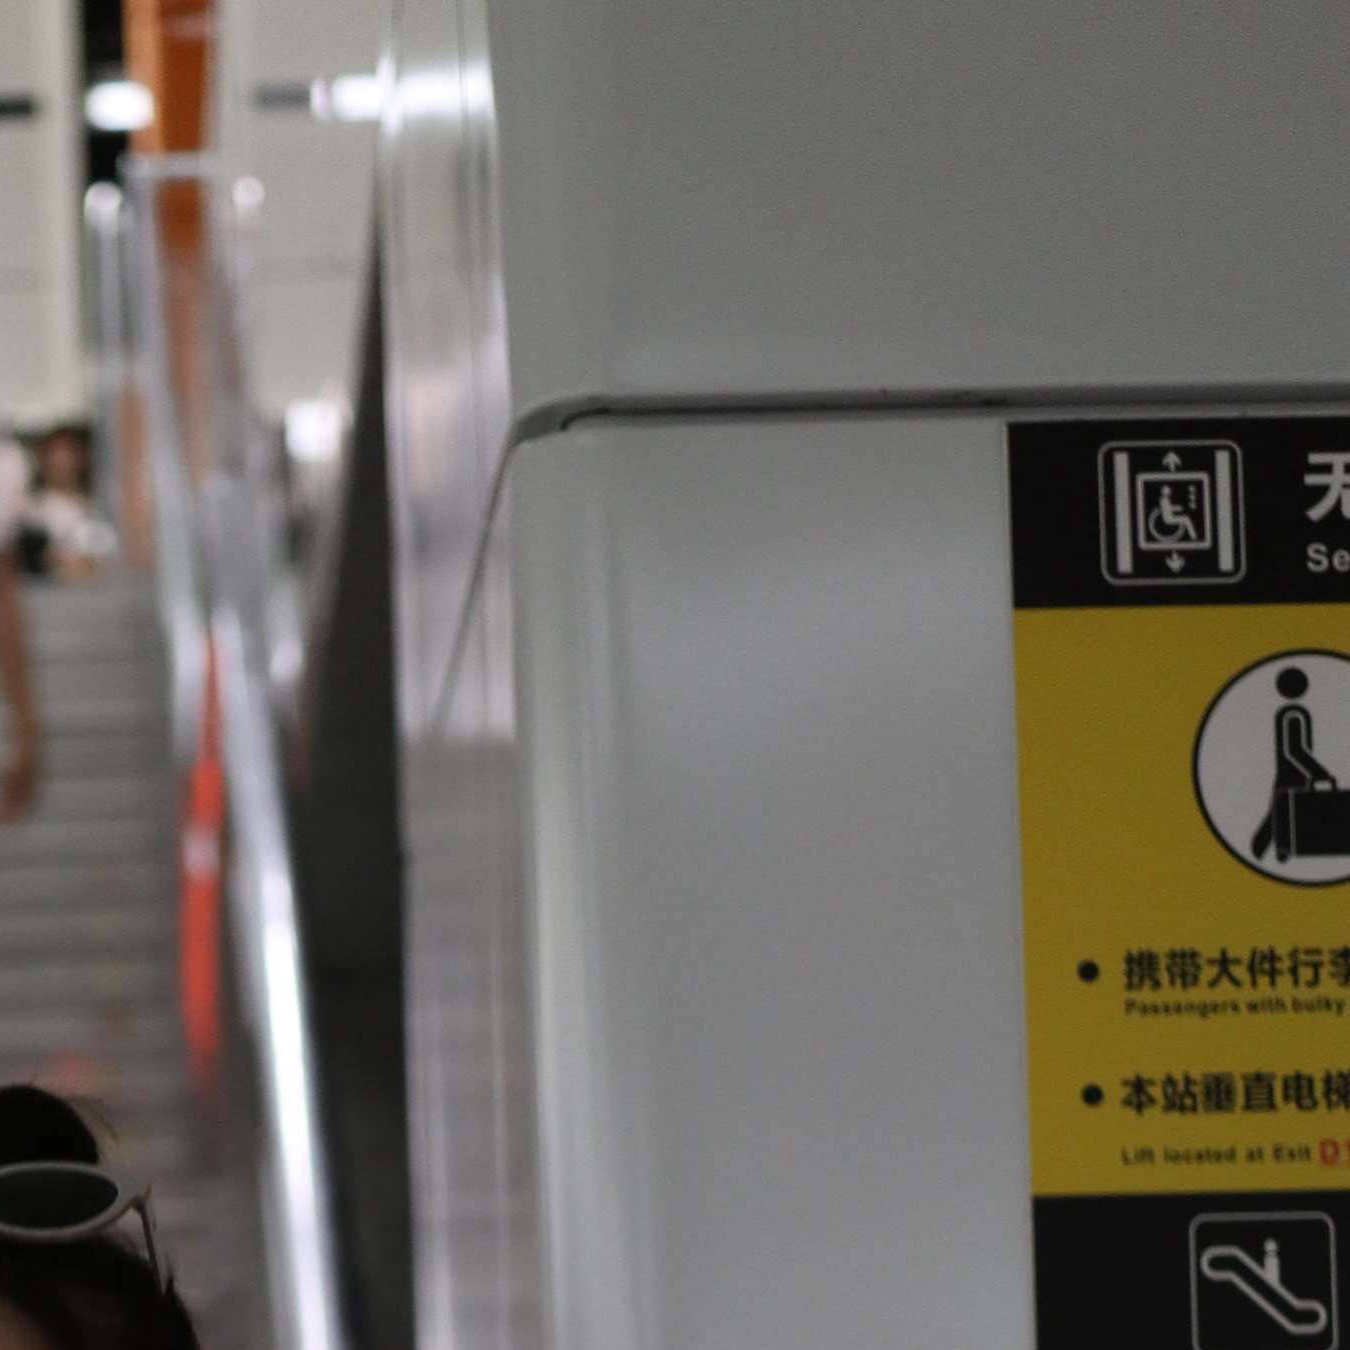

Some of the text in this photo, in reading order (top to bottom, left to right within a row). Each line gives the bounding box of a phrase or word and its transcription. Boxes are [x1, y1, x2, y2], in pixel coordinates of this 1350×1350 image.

[1303, 451, 1350, 520] 无
[1306, 542, 1350, 572] Se
[1246, 997, 1286, 1013] with
[1121, 1146, 1155, 1164] Lift
[1163, 1146, 1236, 1163] located
[1246, 1147, 1263, 1162] at
[1272, 1145, 1311, 1162] Exit
